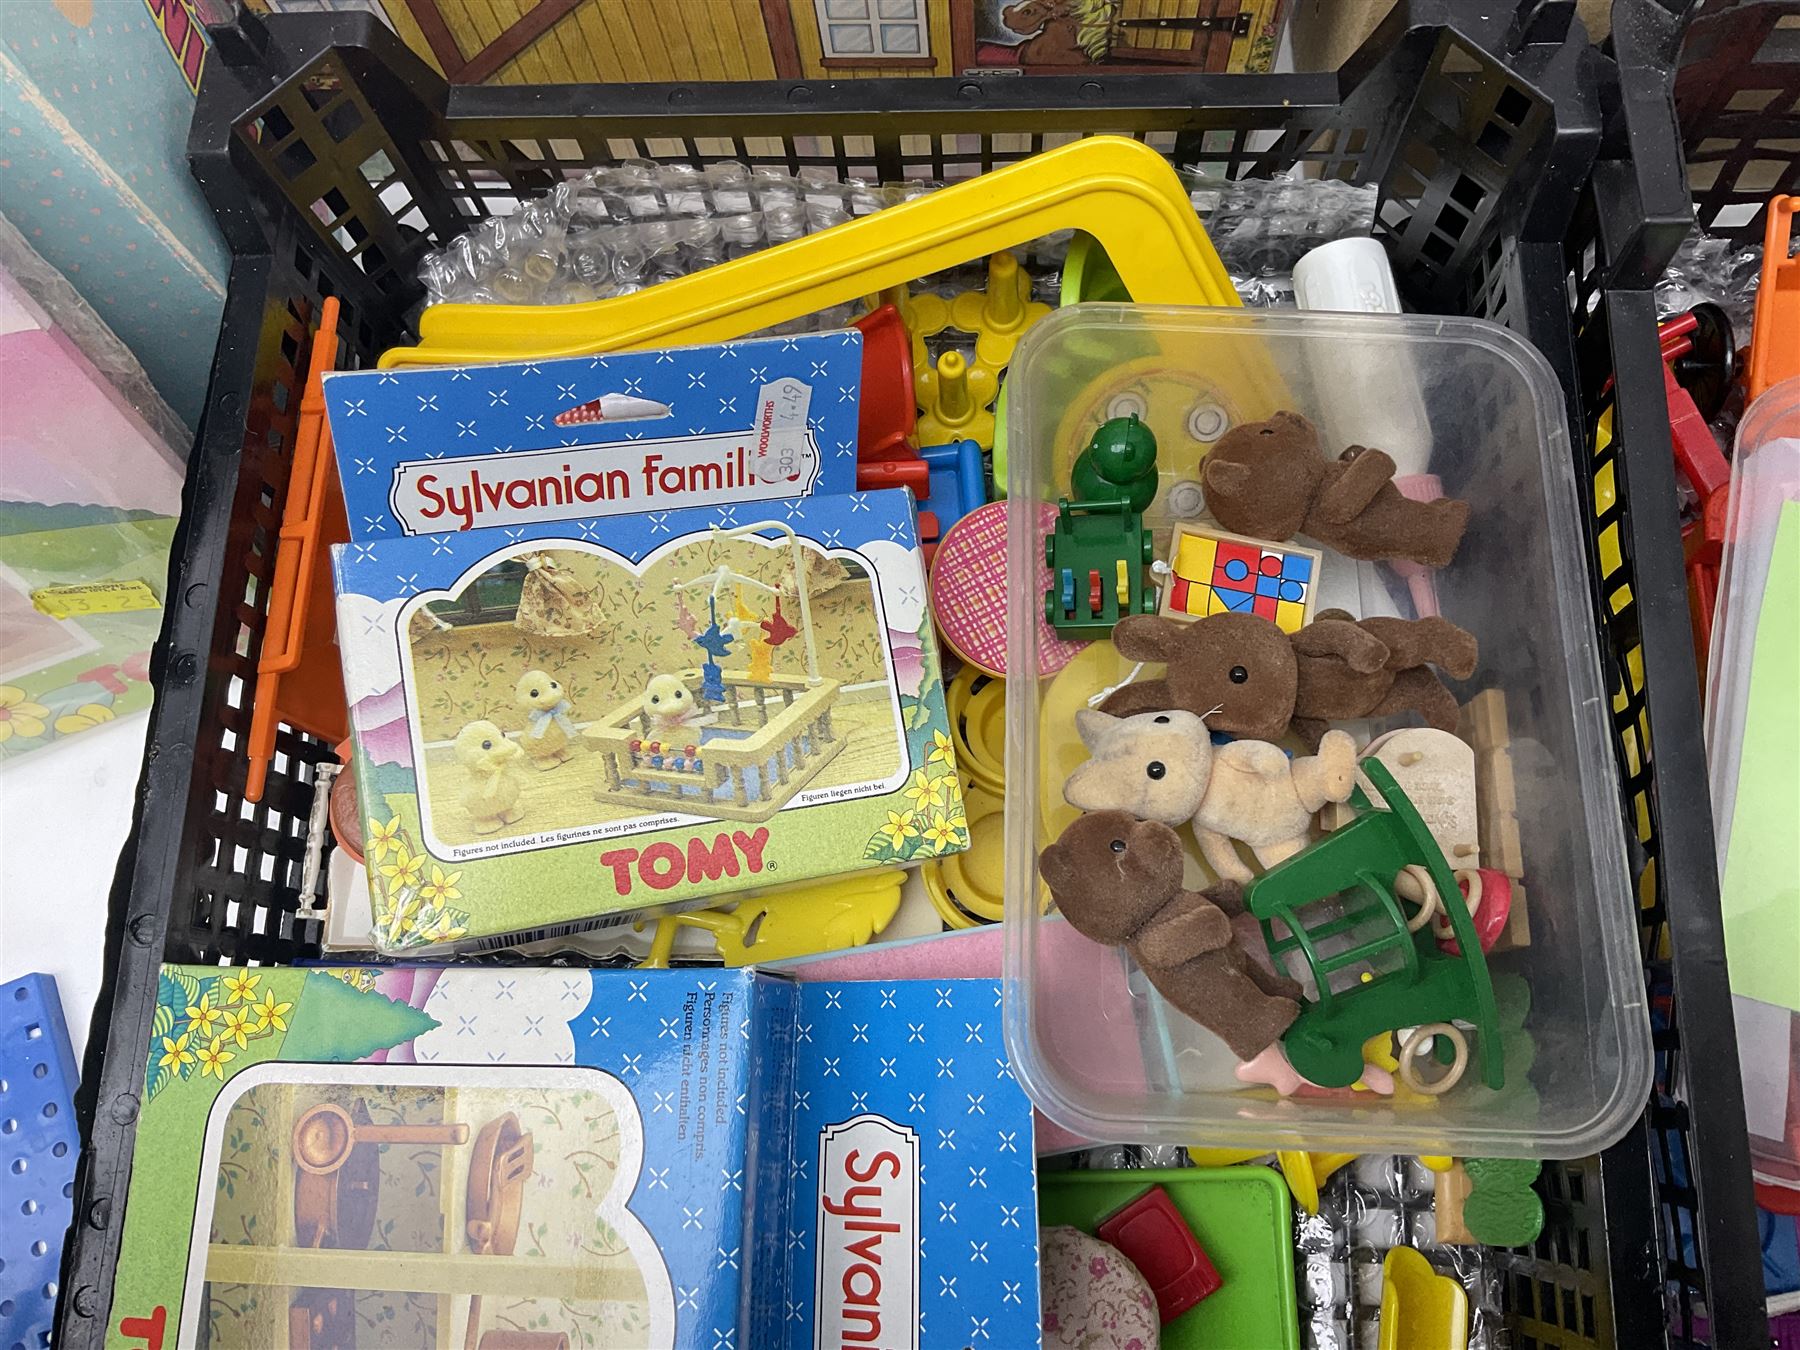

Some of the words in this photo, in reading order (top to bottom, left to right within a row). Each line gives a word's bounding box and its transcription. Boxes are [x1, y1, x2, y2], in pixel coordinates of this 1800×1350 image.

[779, 384, 802, 420] 4.49
[758, 400, 775, 458] WOOLWORTHS
[778, 447, 795, 475] 303
[416, 463, 630, 531] Sylvanian
[642, 446, 801, 495] famil
[801, 791, 829, 802] Figuren
[830, 788, 853, 798] liegen
[854, 784, 872, 794] nicht
[453, 846, 483, 858] Figures
[485, 844, 499, 852] not
[540, 834, 554, 844] Les
[556, 828, 591, 842] figurines
[592, 828, 603, 836] ne
[604, 824, 621, 834] sont
[623, 822, 637, 832] pas
[638, 816, 680, 829] comprises.
[600, 827, 770, 896] TOMY
[682, 992, 698, 1041] Figuren
[697, 992, 716, 1073] Personnages
[718, 992, 733, 1039] Figures
[681, 1044, 693, 1077] nicht
[718, 1043, 729, 1063] not
[676, 1078, 691, 1144] enthalten.
[699, 1076, 709, 1102] non
[714, 1065, 729, 1128] included.
[693, 1104, 706, 1163] compris.
